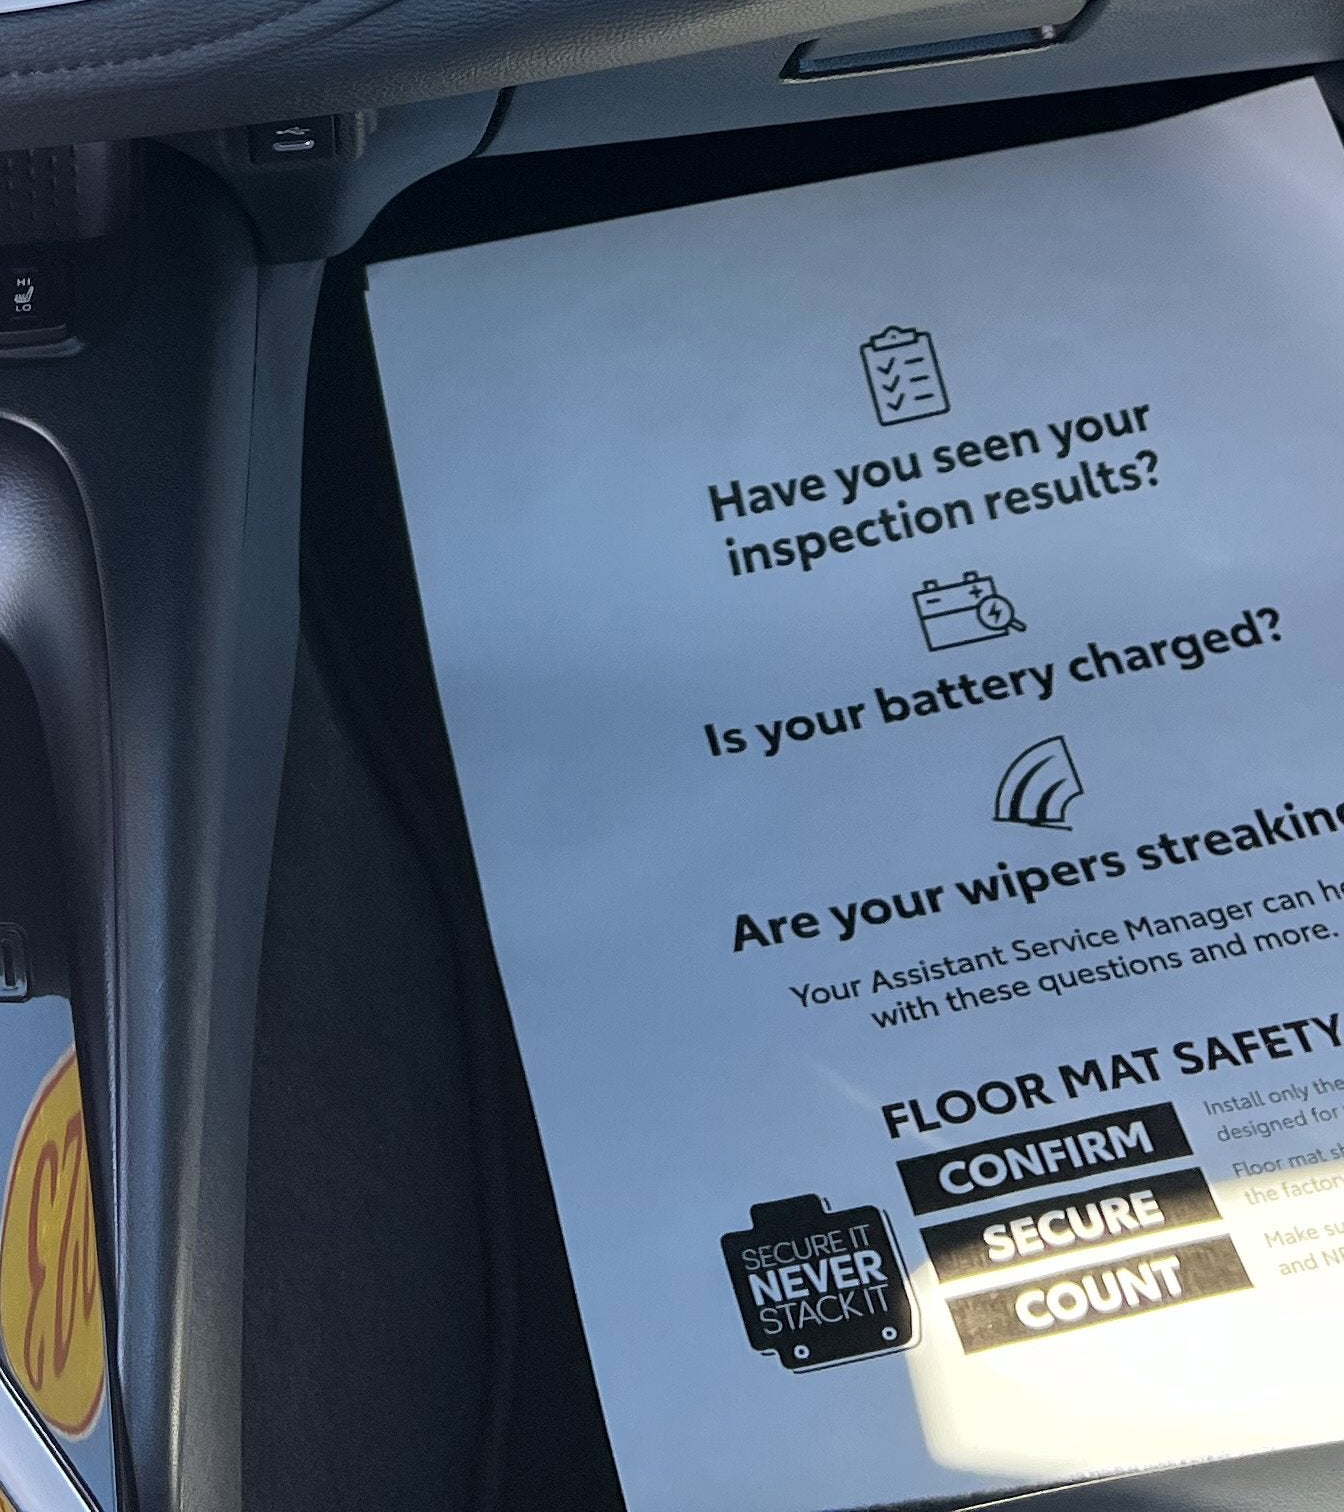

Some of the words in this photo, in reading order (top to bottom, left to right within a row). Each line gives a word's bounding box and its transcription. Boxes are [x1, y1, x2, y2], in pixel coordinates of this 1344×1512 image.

[15, 303, 32, 312] LO
[17, 277, 31, 286] HI
[708, 474, 826, 522] Have
[834, 453, 922, 505] you
[933, 428, 1040, 473] seen
[1047, 404, 1150, 459] your
[725, 500, 974, 576] inspection
[984, 449, 1158, 520] results?
[703, 724, 747, 756] Is
[755, 703, 865, 757] your
[874, 663, 1054, 723] battery
[1069, 607, 1281, 682] charged?
[733, 912, 820, 953] Are
[828, 886, 944, 942] your
[954, 851, 1126, 905] wipers
[788, 979, 861, 1008] Your
[872, 946, 1008, 993] Assistant
[1011, 928, 1120, 961] Service
[1123, 900, 1253, 941] Manager
[1262, 890, 1315, 913] can
[870, 996, 940, 1028] with
[945, 981, 1031, 1012] these
[1038, 952, 1183, 996] questions
[1190, 932, 1247, 964] and
[1253, 923, 1340, 952] more.
[881, 1073, 1054, 1139] FLOOR
[1058, 1047, 1160, 1098] MAT
[1173, 1013, 1342, 1075] SAFETY
[1202, 1090, 1266, 1116] Install
[1268, 1083, 1308, 1103] only
[1217, 1110, 1308, 1142] designed
[1311, 1107, 1338, 1123] for
[937, 1121, 1156, 1198] CONFIRM
[1232, 1159, 1282, 1179] Floor
[1289, 1150, 1327, 1167] mat
[1245, 1189, 1279, 1205] the
[741, 1229, 847, 1271] SECURE
[848, 1223, 871, 1249] IT
[982, 1189, 1166, 1266] SECURE
[1263, 1226, 1320, 1248] Make
[747, 1249, 889, 1306] NEVER
[1278, 1253, 1319, 1276] and
[759, 1290, 864, 1335] STACK
[863, 1283, 889, 1315] IT
[1015, 1257, 1182, 1334] COUNT
